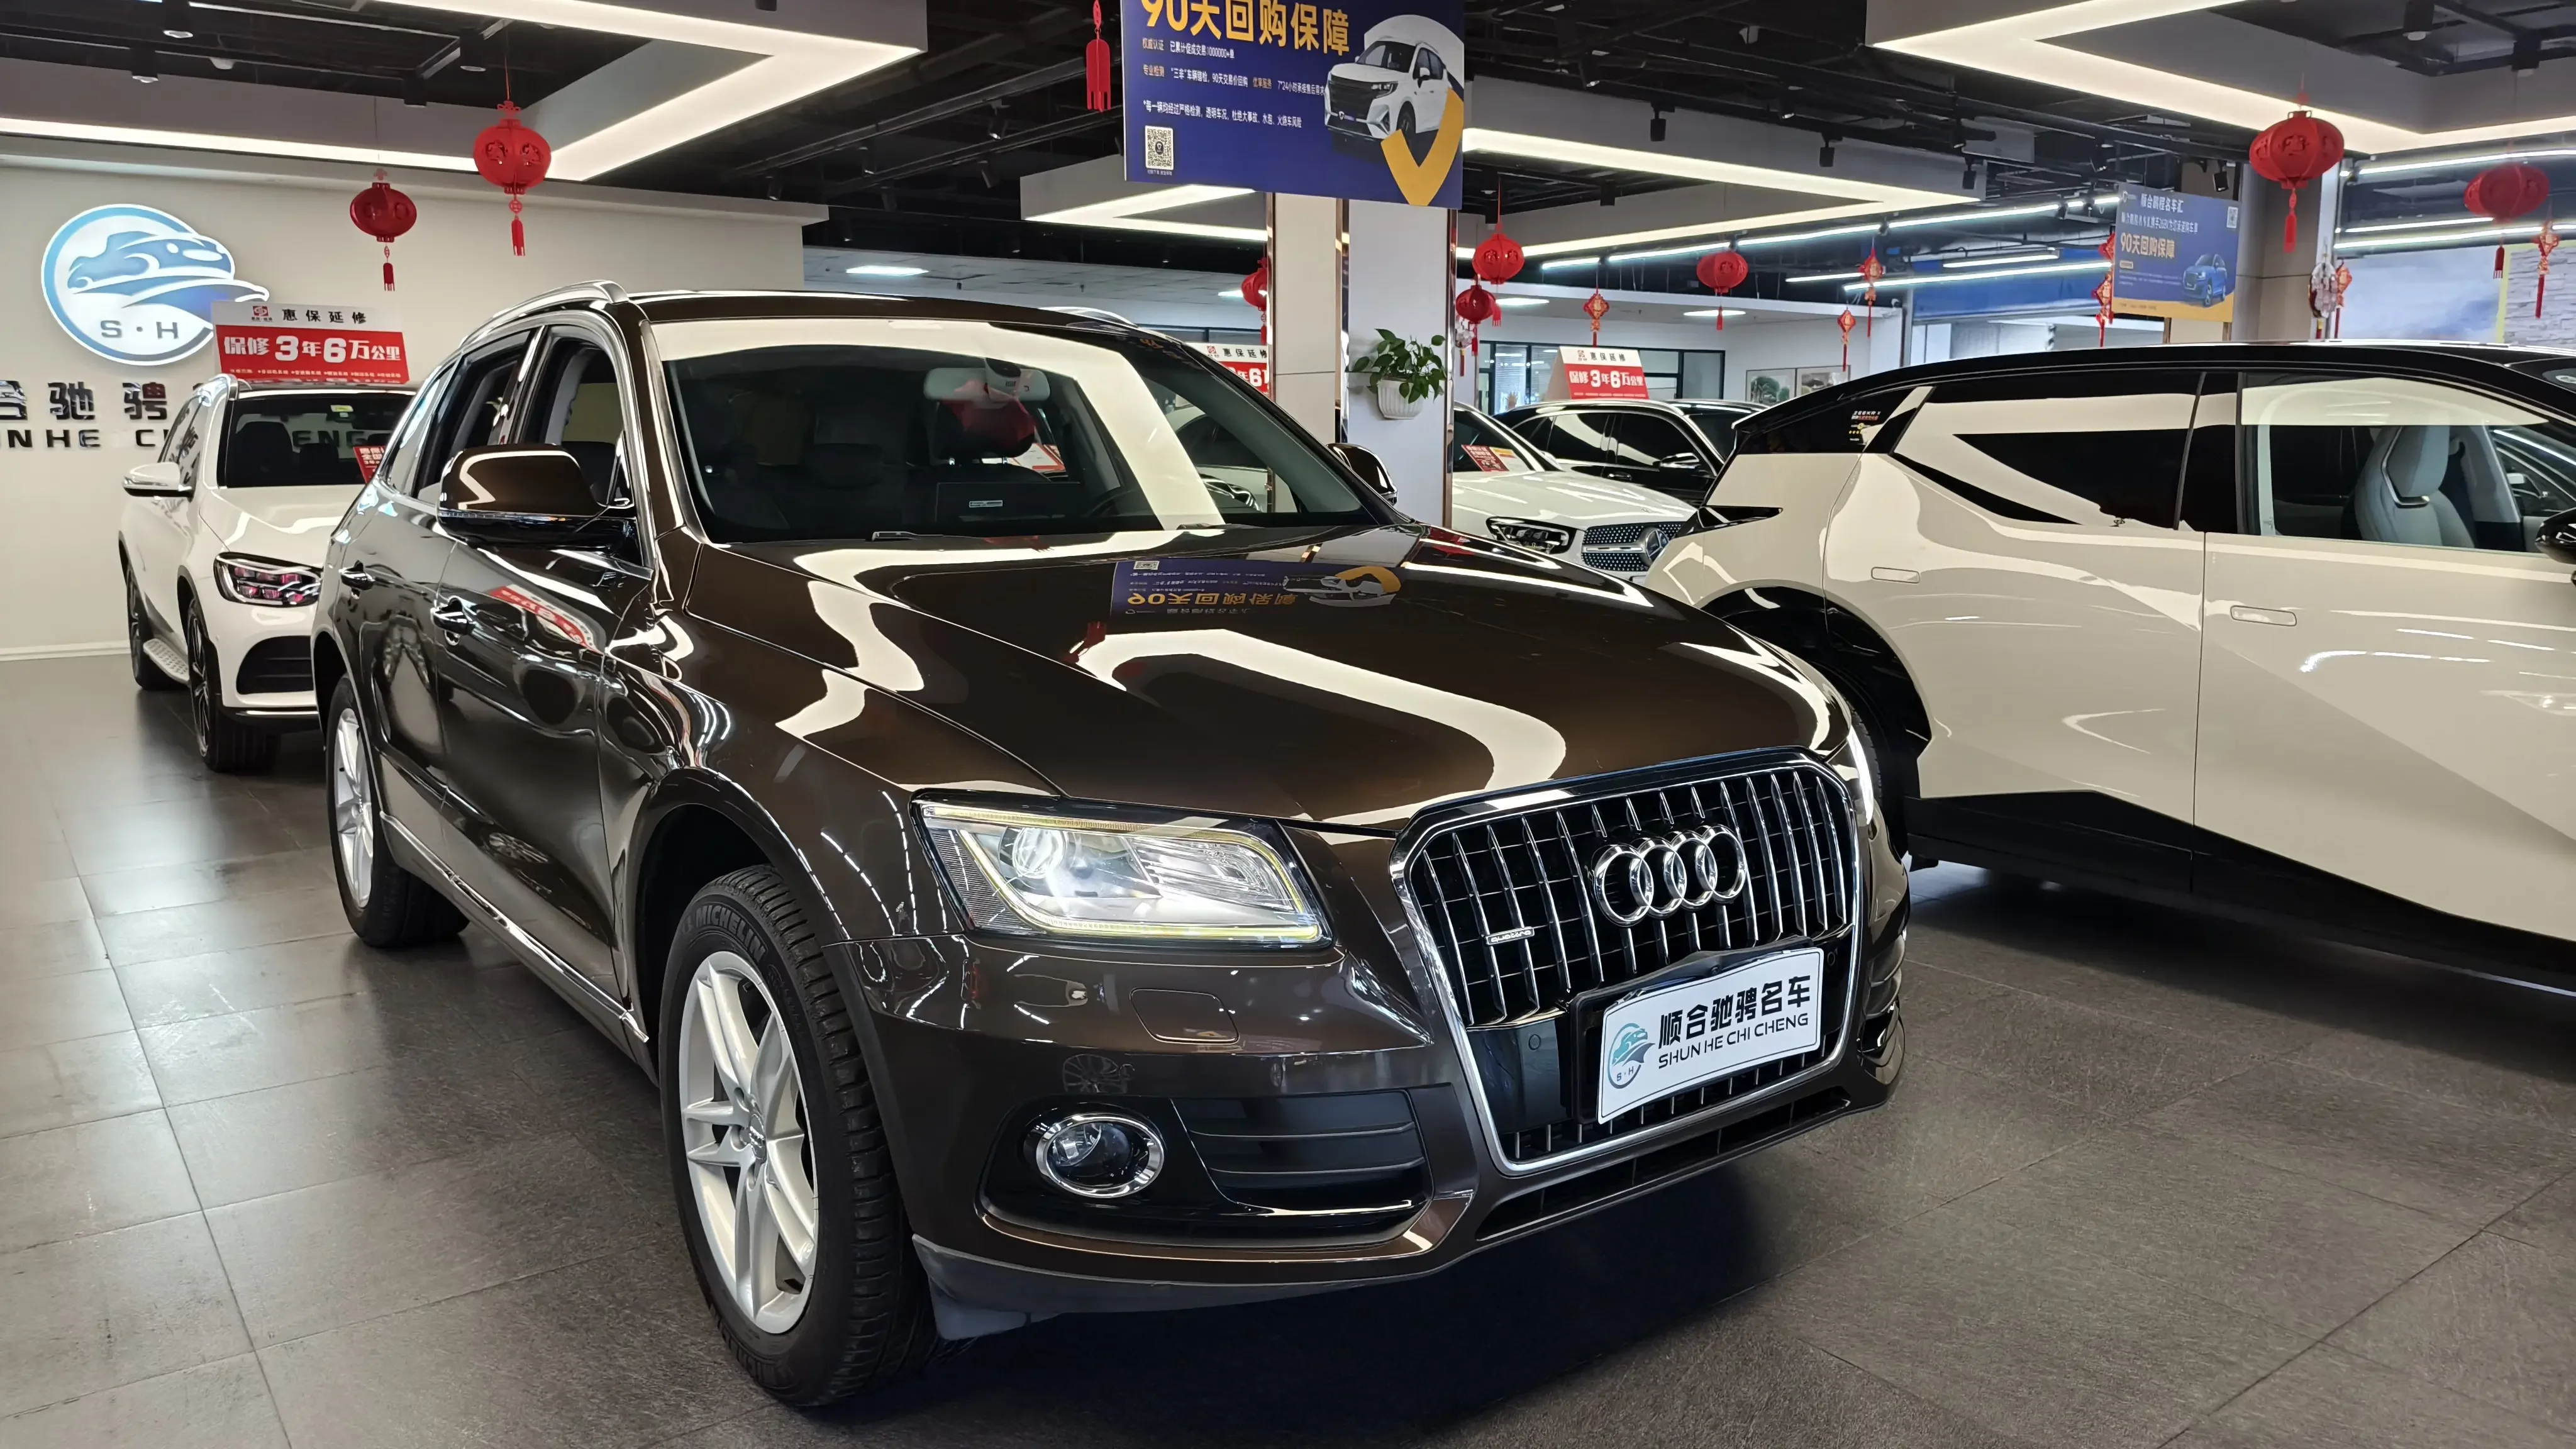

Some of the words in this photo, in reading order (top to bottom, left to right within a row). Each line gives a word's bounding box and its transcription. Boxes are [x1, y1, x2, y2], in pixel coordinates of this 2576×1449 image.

[282, 308, 367, 325] 惠保延修
[224, 335, 401, 364] 保修3年6万公里
[45, 429, 101, 448] HE
[696, 904, 766, 963] MICHELIN
[1491, 930, 1531, 943] quattro
[1658, 975, 1811, 1050] 顺合驰骋名车
[1658, 1042, 1701, 1069] SHUN
[1704, 1035, 1723, 1054] HE
[1726, 1027, 1750, 1045] CHI
[1754, 1013, 1808, 1037] CHENG
